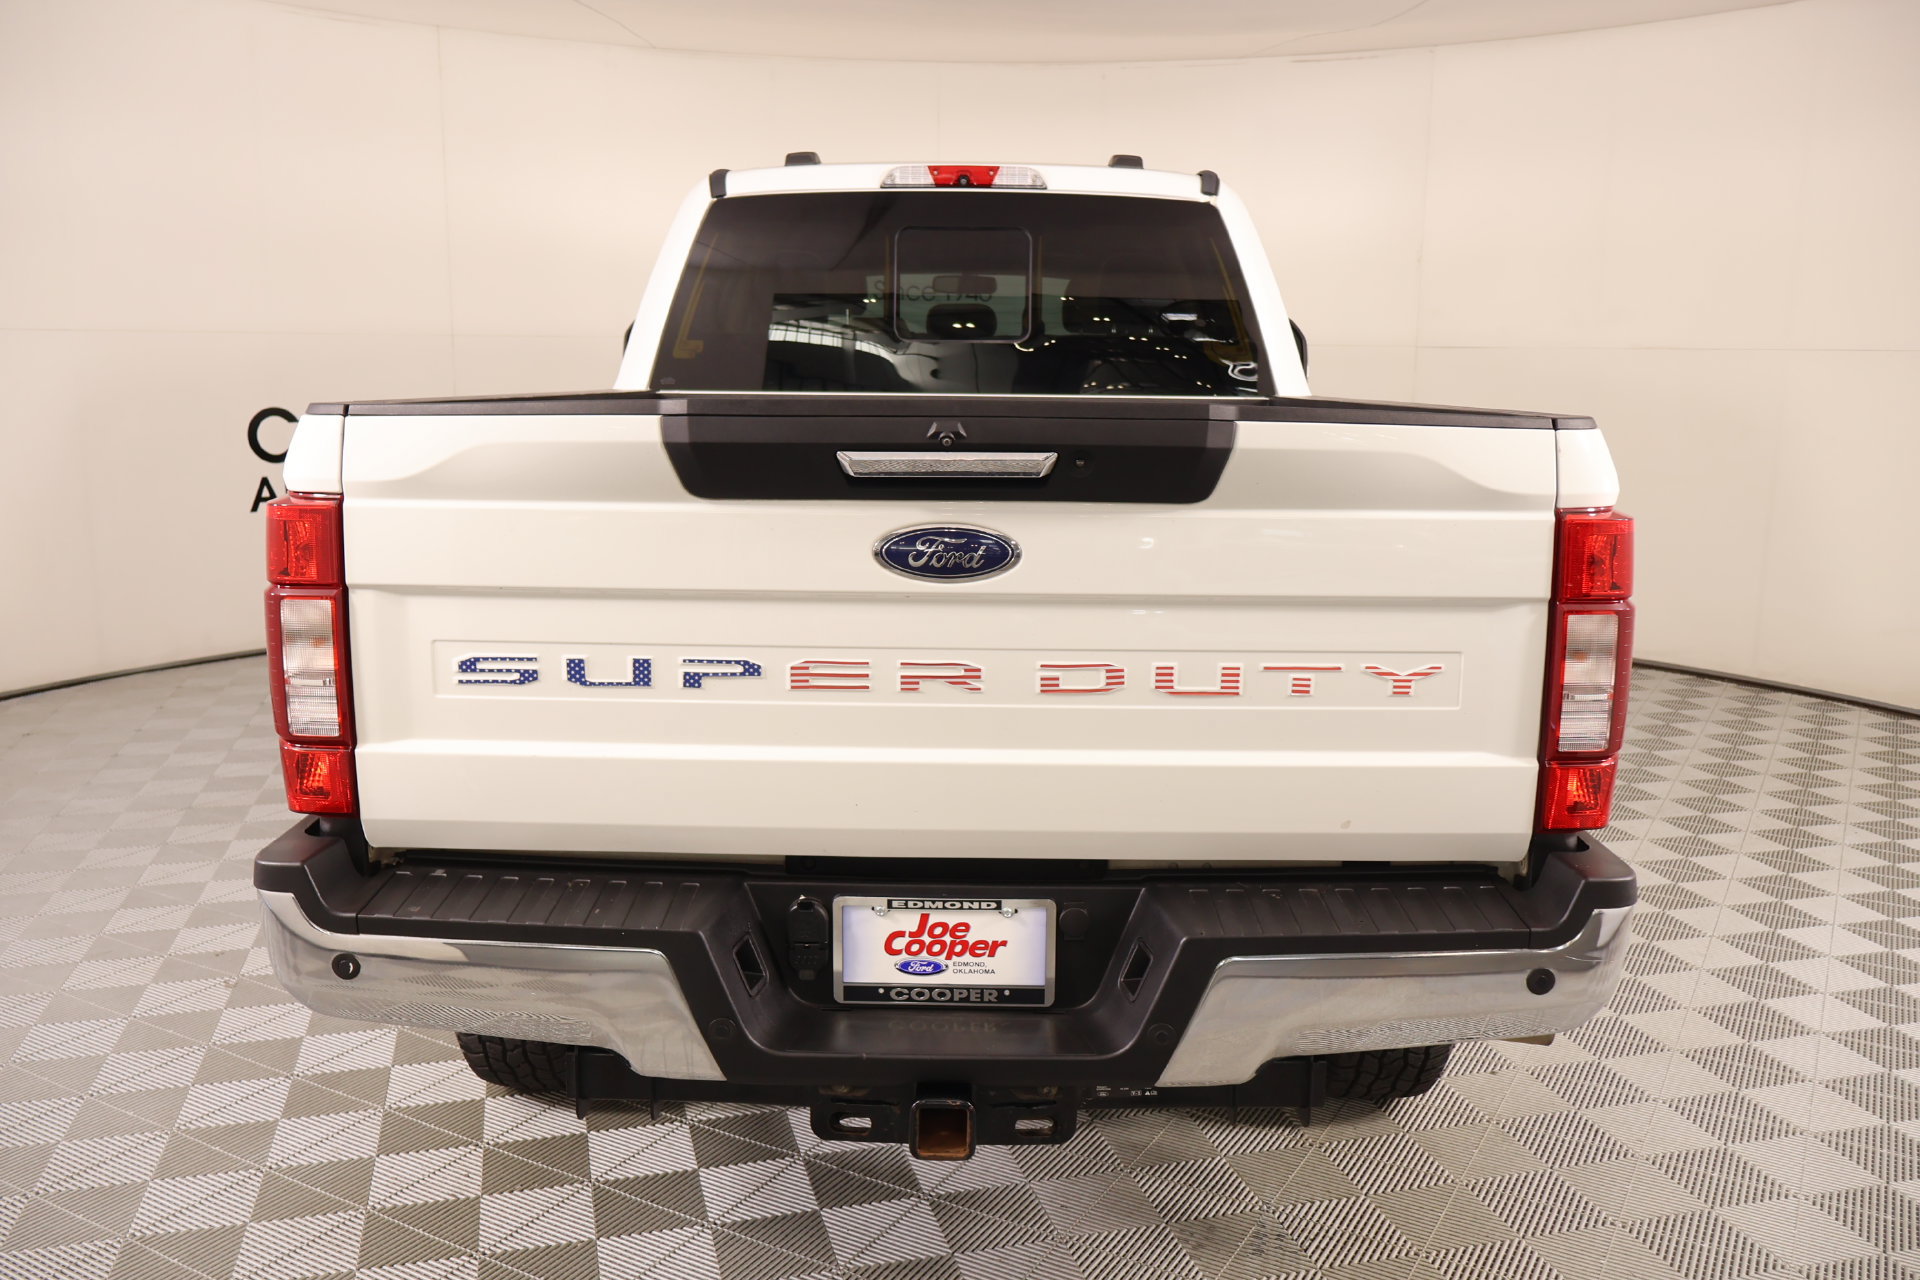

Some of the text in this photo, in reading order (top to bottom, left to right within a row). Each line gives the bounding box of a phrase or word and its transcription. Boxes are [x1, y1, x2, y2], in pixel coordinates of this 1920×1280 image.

[908, 535, 986, 569] Ford
[457, 655, 1444, 696] SUPER DUTY
[891, 900, 998, 910] EDMOND
[908, 913, 971, 940] Joe
[884, 930, 1008, 961] Cooper
[907, 960, 934, 973] Ford
[889, 987, 998, 1002] COOPER
